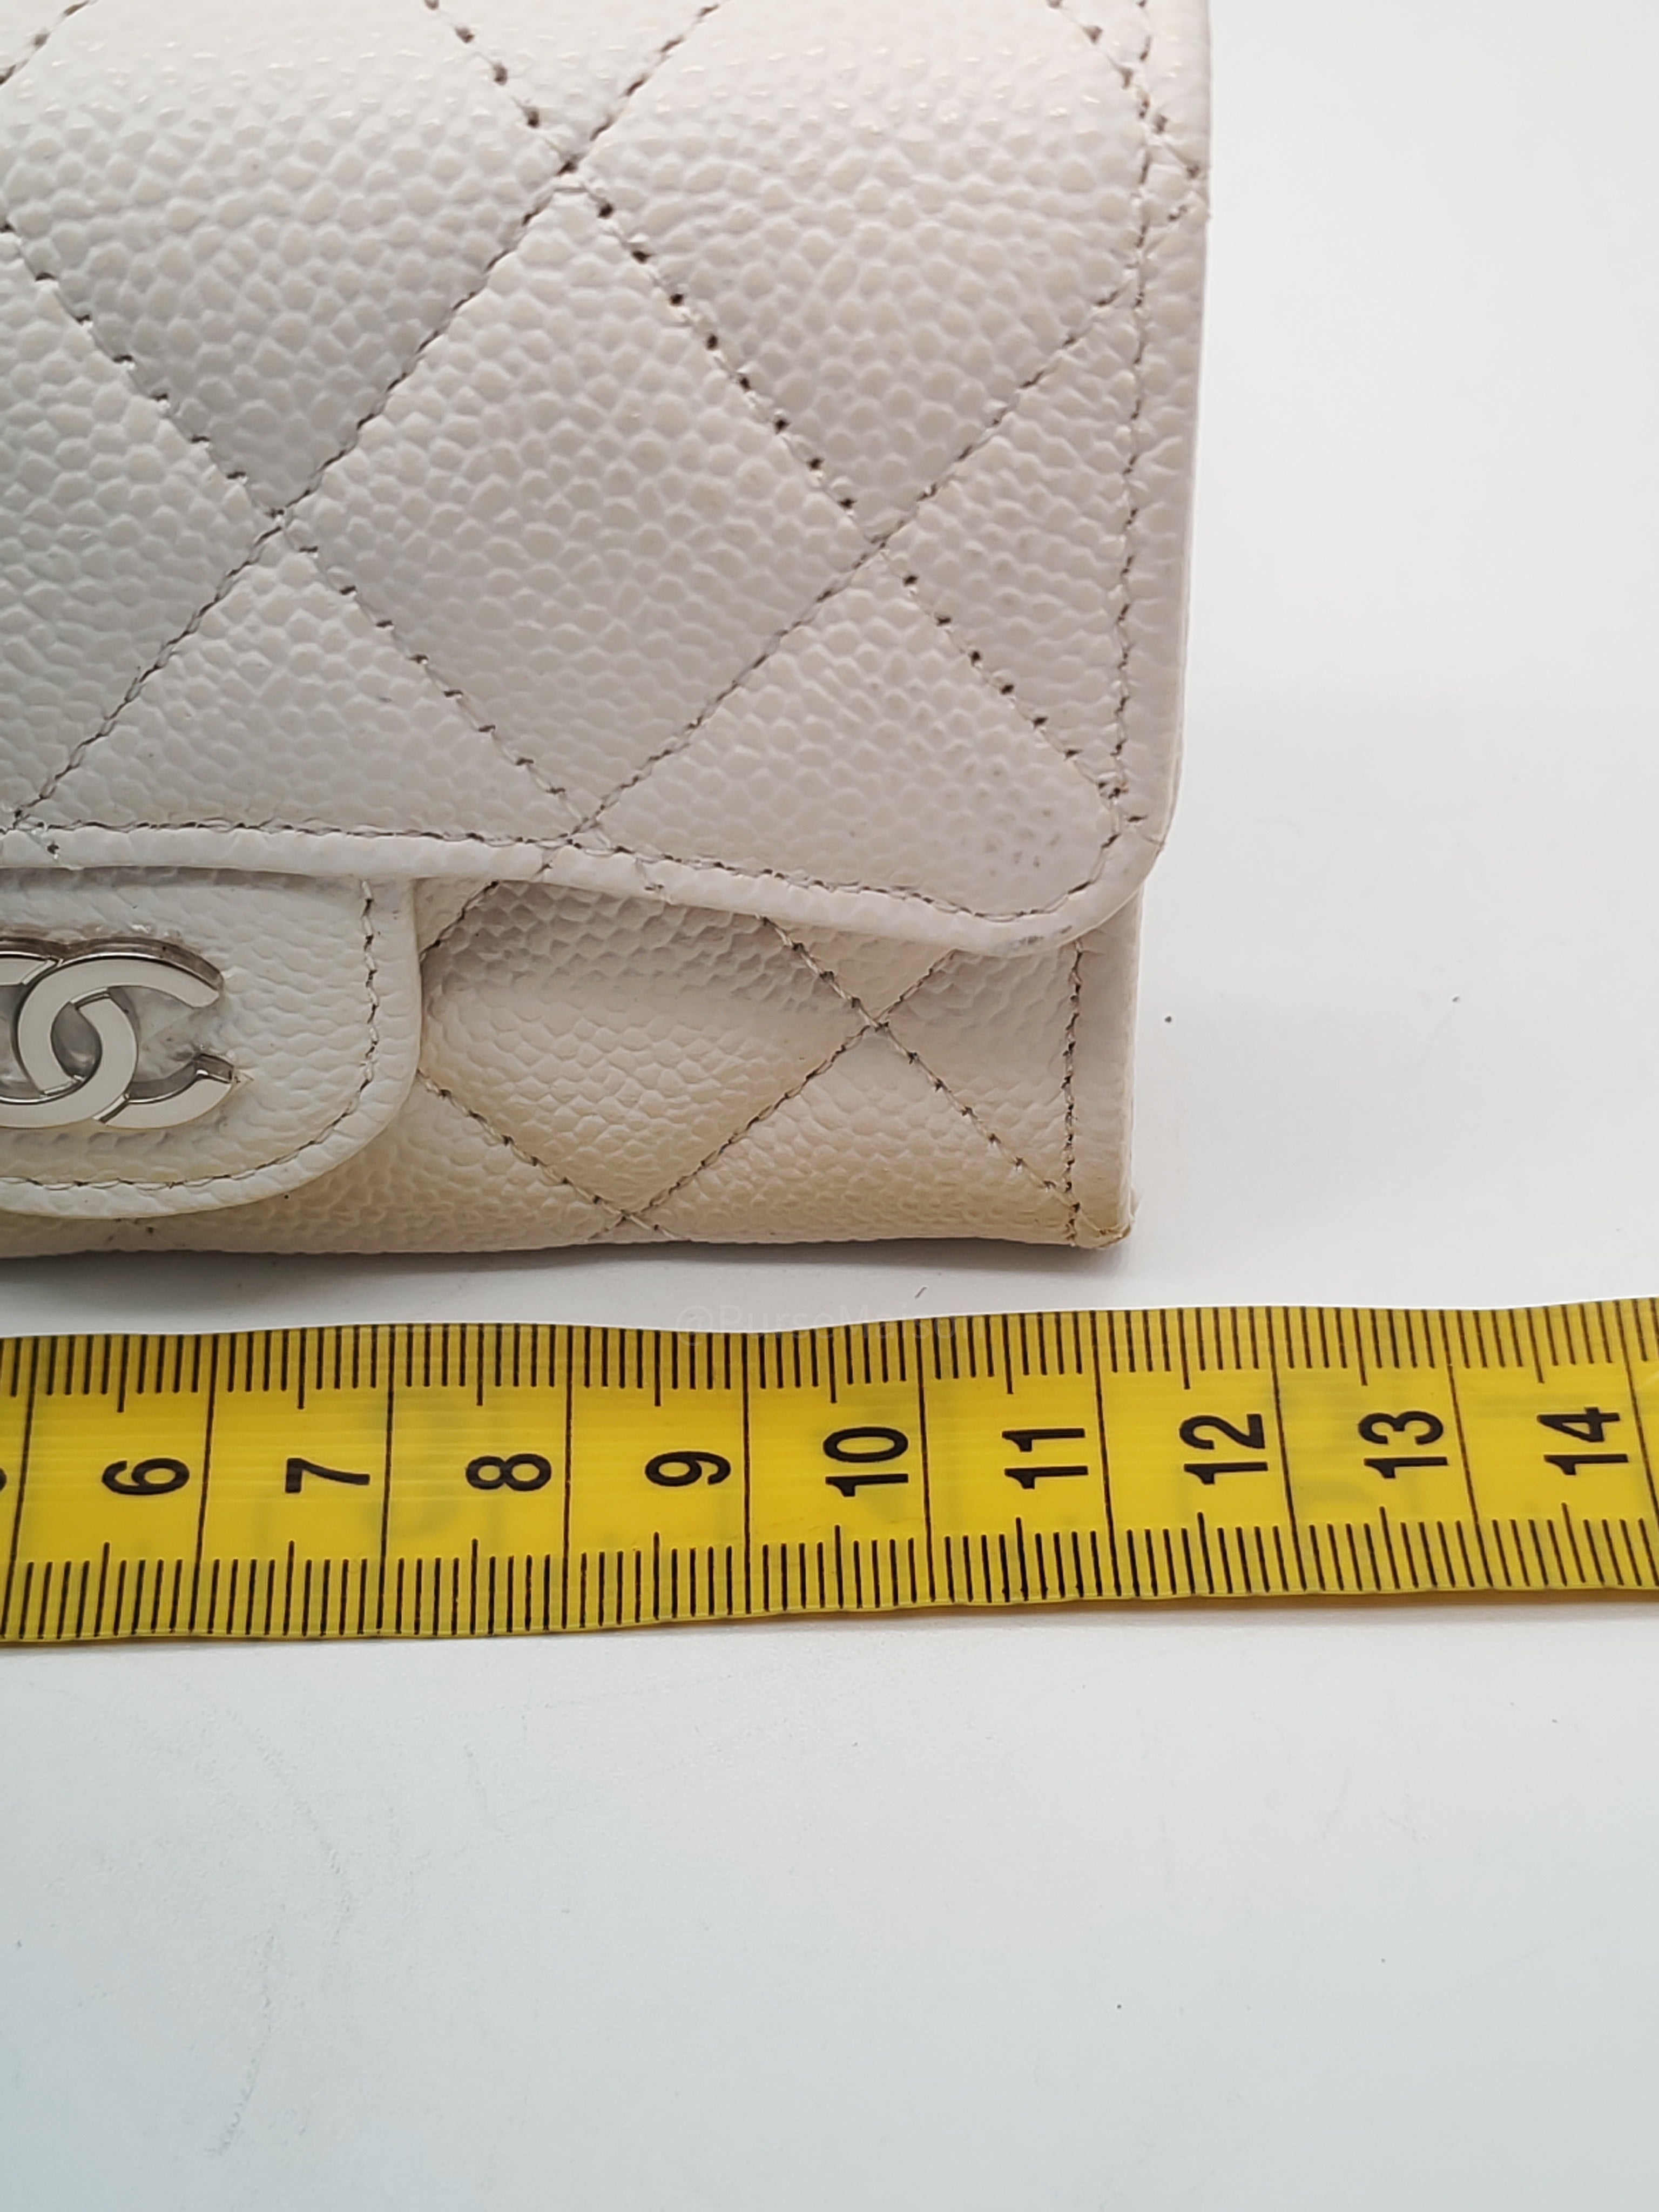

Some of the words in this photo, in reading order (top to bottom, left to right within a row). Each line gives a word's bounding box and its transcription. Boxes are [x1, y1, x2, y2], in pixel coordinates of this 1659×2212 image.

[645, 1452, 731, 1487] 9
[823, 1427, 908, 1497] 10
[1002, 1428, 1088, 1489] 11
[1180, 1414, 1268, 1485] 12
[1359, 1411, 1448, 1478] 13
[1538, 1408, 1628, 1475] 14
[102, 1458, 189, 1495] 6
[285, 1458, 370, 1493] 7
[466, 1454, 551, 1491] 8
